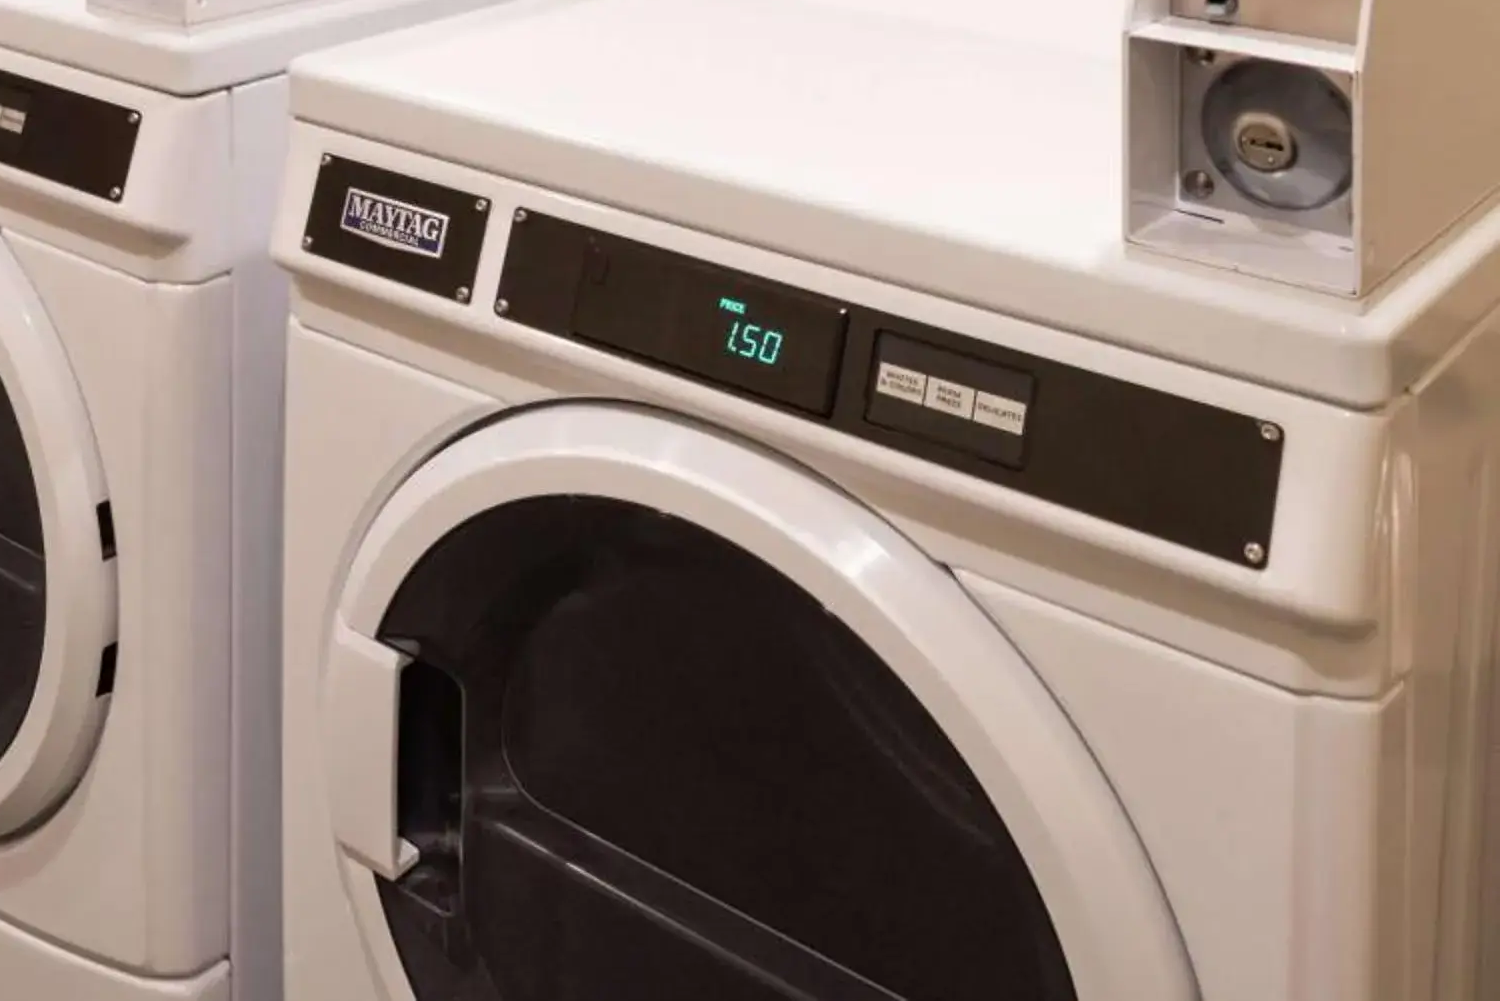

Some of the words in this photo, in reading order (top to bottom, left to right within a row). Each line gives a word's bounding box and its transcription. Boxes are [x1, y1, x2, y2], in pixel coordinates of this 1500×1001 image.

[347, 195, 440, 241] MAYTAG
[360, 220, 419, 248] COMMERCIAL
[727, 320, 783, 364] 1.50
